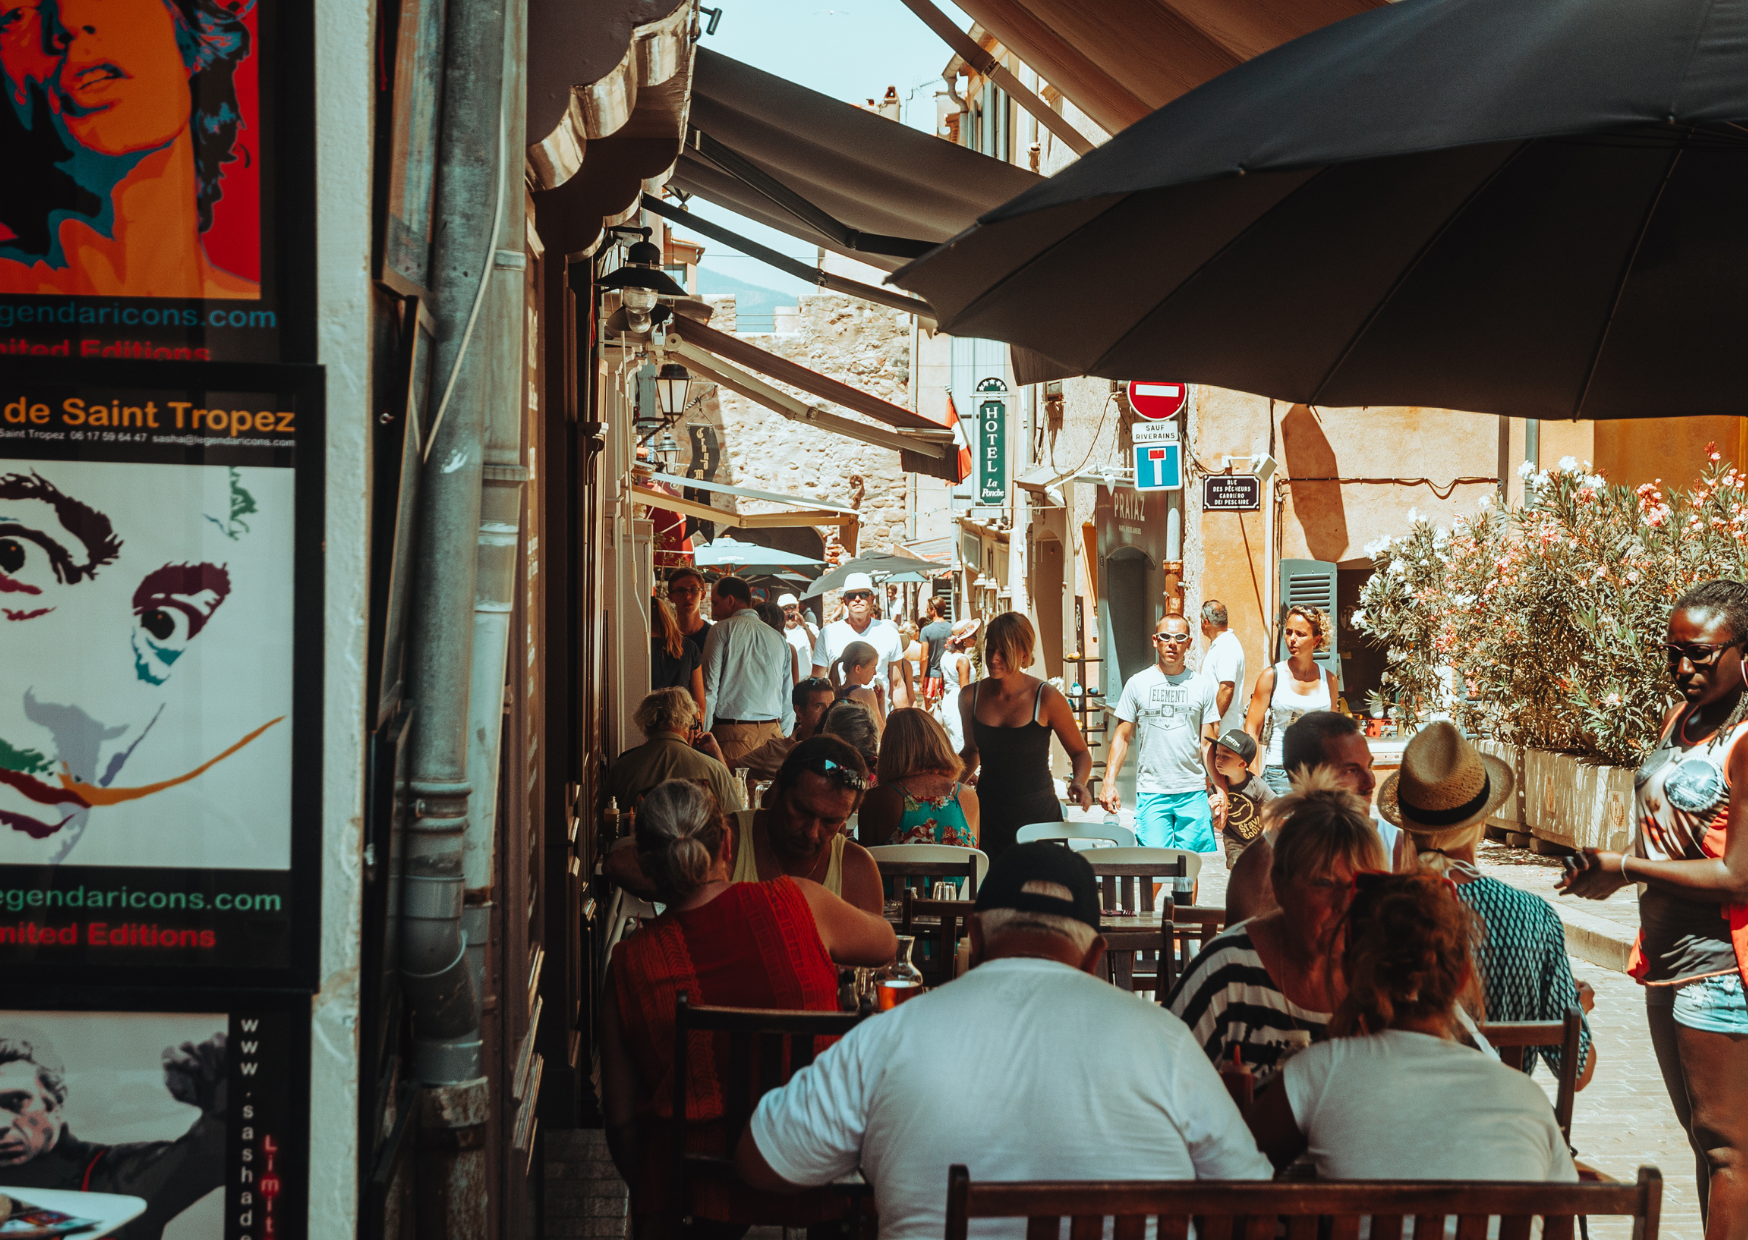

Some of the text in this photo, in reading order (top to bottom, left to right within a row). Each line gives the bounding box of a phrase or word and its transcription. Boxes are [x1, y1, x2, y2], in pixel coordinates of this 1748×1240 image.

[4, 396, 296, 437] de Saint Tropez
[28, 429, 65, 441] Tropez
[86, 431, 100, 440] 17
[133, 432, 148, 442] 47
[985, 406, 998, 472] HOTEL
[1135, 432, 1176, 440] RIVERAINS
[986, 478, 998, 487] La
[982, 488, 1005, 498] Ponche
[1114, 492, 1145, 522] PRAIAZ
[1151, 689, 1186, 703] ELEMENT
[88, 922, 216, 947] Editions
